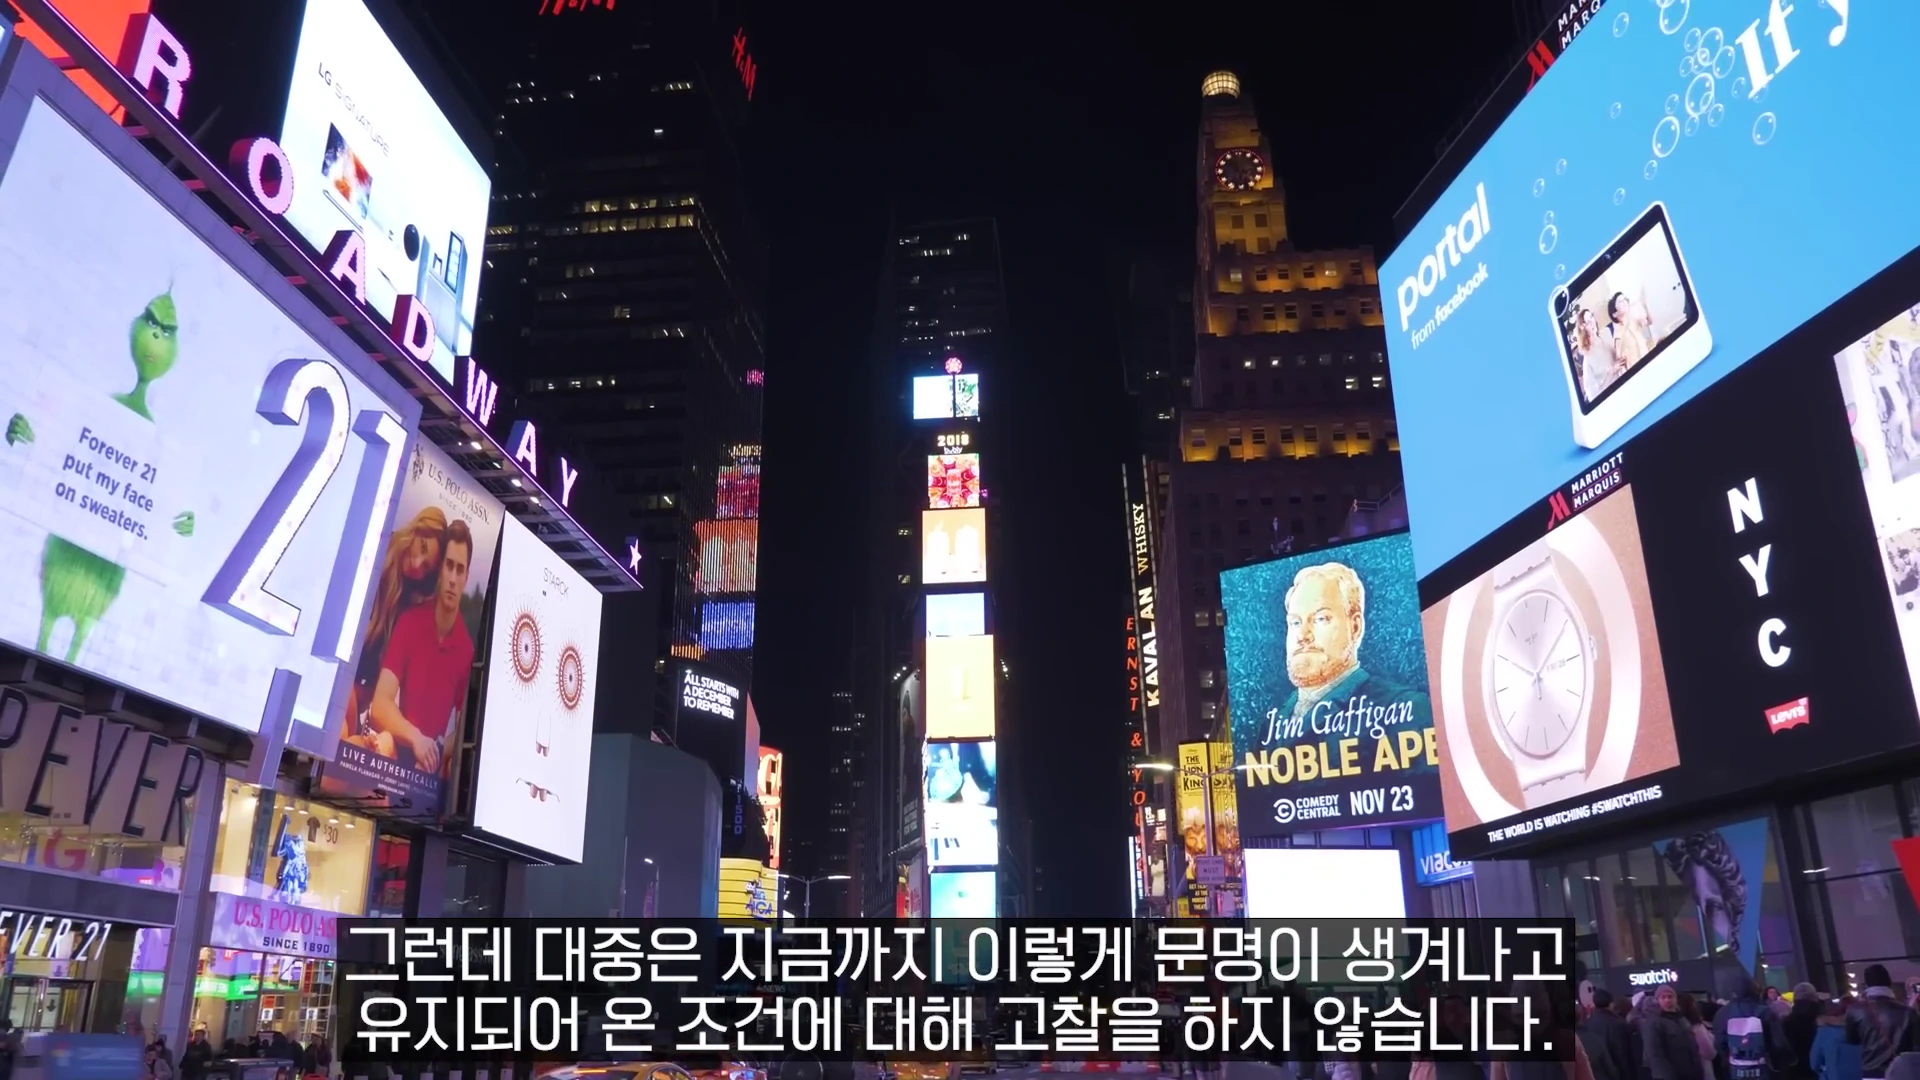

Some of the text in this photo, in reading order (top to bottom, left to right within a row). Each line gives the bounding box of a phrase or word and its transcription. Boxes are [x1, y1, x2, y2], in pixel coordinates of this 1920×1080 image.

[318, 62, 390, 157] LG SIGNATURE
[1397, 182, 1490, 332] portal
[1411, 262, 1488, 350] from facebook
[79, 426, 157, 484] Forever 21
[1571, 452, 1623, 495] MARRIOTT
[62, 454, 153, 512] put my face
[428, 463, 490, 525] U.S. POLO ASSN.
[1573, 471, 1620, 508] MARQUIS
[55, 482, 148, 540] on sweaters.
[201, 358, 408, 664] 21
[543, 567, 570, 596] STARCK
[1132, 503, 1160, 707] KAVALAN WHISKY
[1126, 616, 1139, 712] ERNST
[683, 684, 732, 708] A DECEMBER
[683, 695, 735, 720] TO REMEMBER
[700, 676, 726, 694] STARTS
[725, 684, 739, 700] WITH
[1261, 695, 1414, 746] Jim Gaffigan
[342, 746, 366, 764] LIVE
[369, 757, 439, 790] AUTHENTICALLY
[1185, 755, 1200, 764] THE
[1245, 738, 1362, 788] NOBLE
[1373, 727, 1440, 773] APE
[1296, 794, 1339, 808] COMEDY
[1297, 806, 1341, 820] CENTRAL
[1350, 785, 1414, 816] NOV 23
[1487, 785, 1663, 843] THE WORLD IS WATCHING #SWATCHTHIS
[1420, 850, 1474, 876] viac
[233, 900, 265, 929] U.S.
[268, 904, 314, 936] POLO
[76, 921, 112, 961] 21
[262, 936, 330, 954] SINCE 1890
[1629, 968, 1671, 986] swatch
